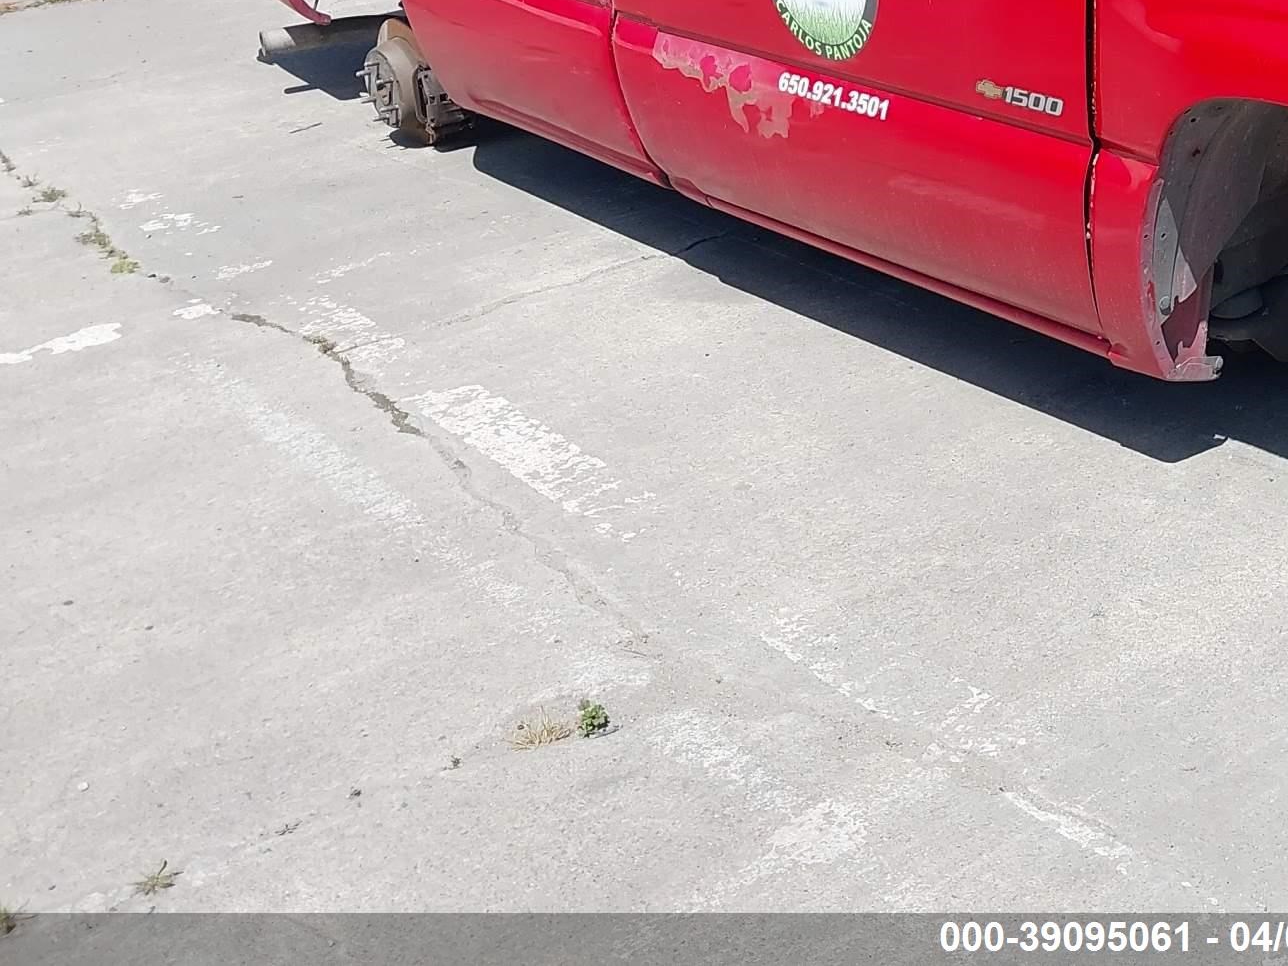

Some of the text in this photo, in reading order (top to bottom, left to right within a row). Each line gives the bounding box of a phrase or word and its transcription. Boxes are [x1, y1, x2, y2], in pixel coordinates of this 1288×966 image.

[825, 18, 873, 62] PANTOJA
[778, 71, 890, 121] 650.921.3501
[1004, 86, 1064, 117] 1500
